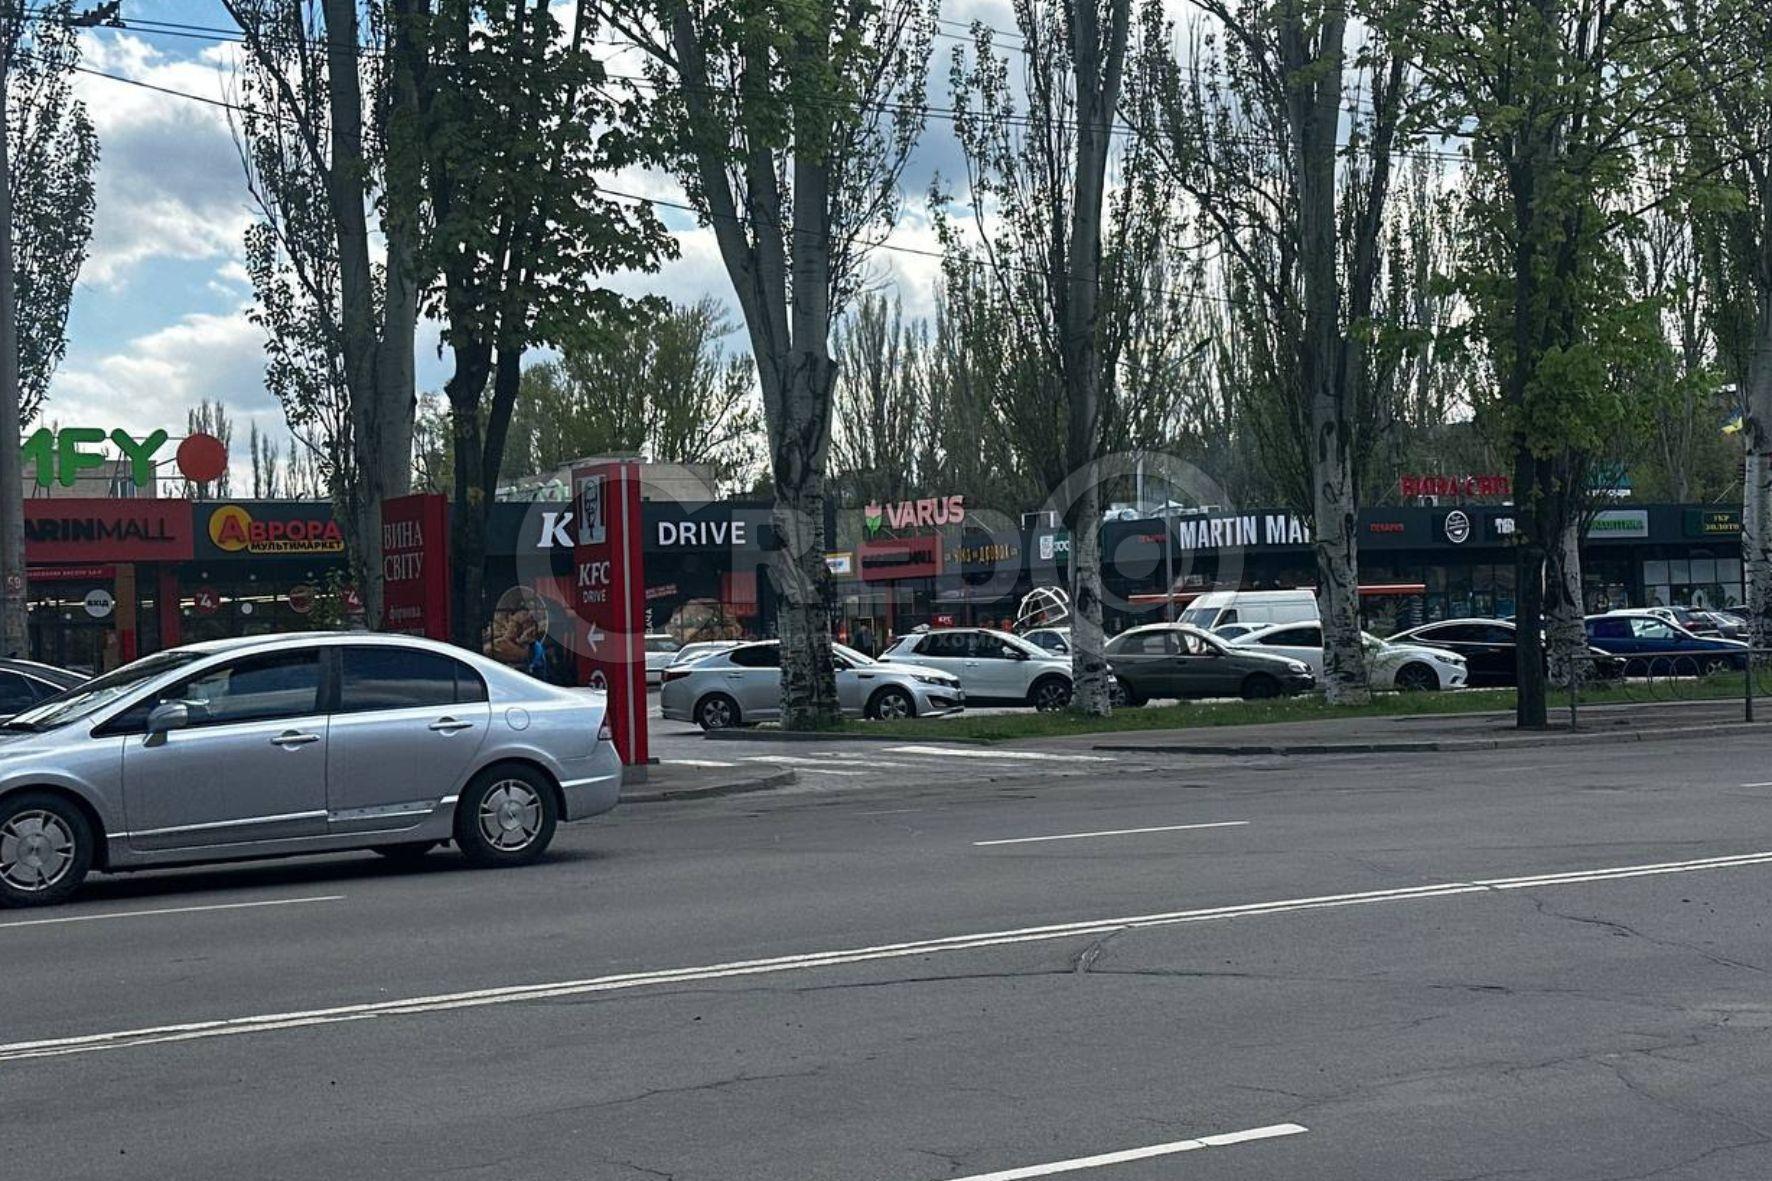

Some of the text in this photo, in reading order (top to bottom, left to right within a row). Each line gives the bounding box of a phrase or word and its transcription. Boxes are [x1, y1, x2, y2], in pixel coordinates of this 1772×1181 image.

[885, 494, 965, 530] VARUS
[217, 514, 343, 544] АВРОРА
[383, 520, 423, 549] ВИНА
[658, 520, 747, 546] DRIVE
[1179, 515, 1258, 550] MARTIN
[251, 540, 341, 551] МУЛЬТИМАРКЕТ
[383, 551, 424, 582] СВІТУ
[578, 561, 611, 587] KFC
[582, 588, 606, 604] DRIVE
